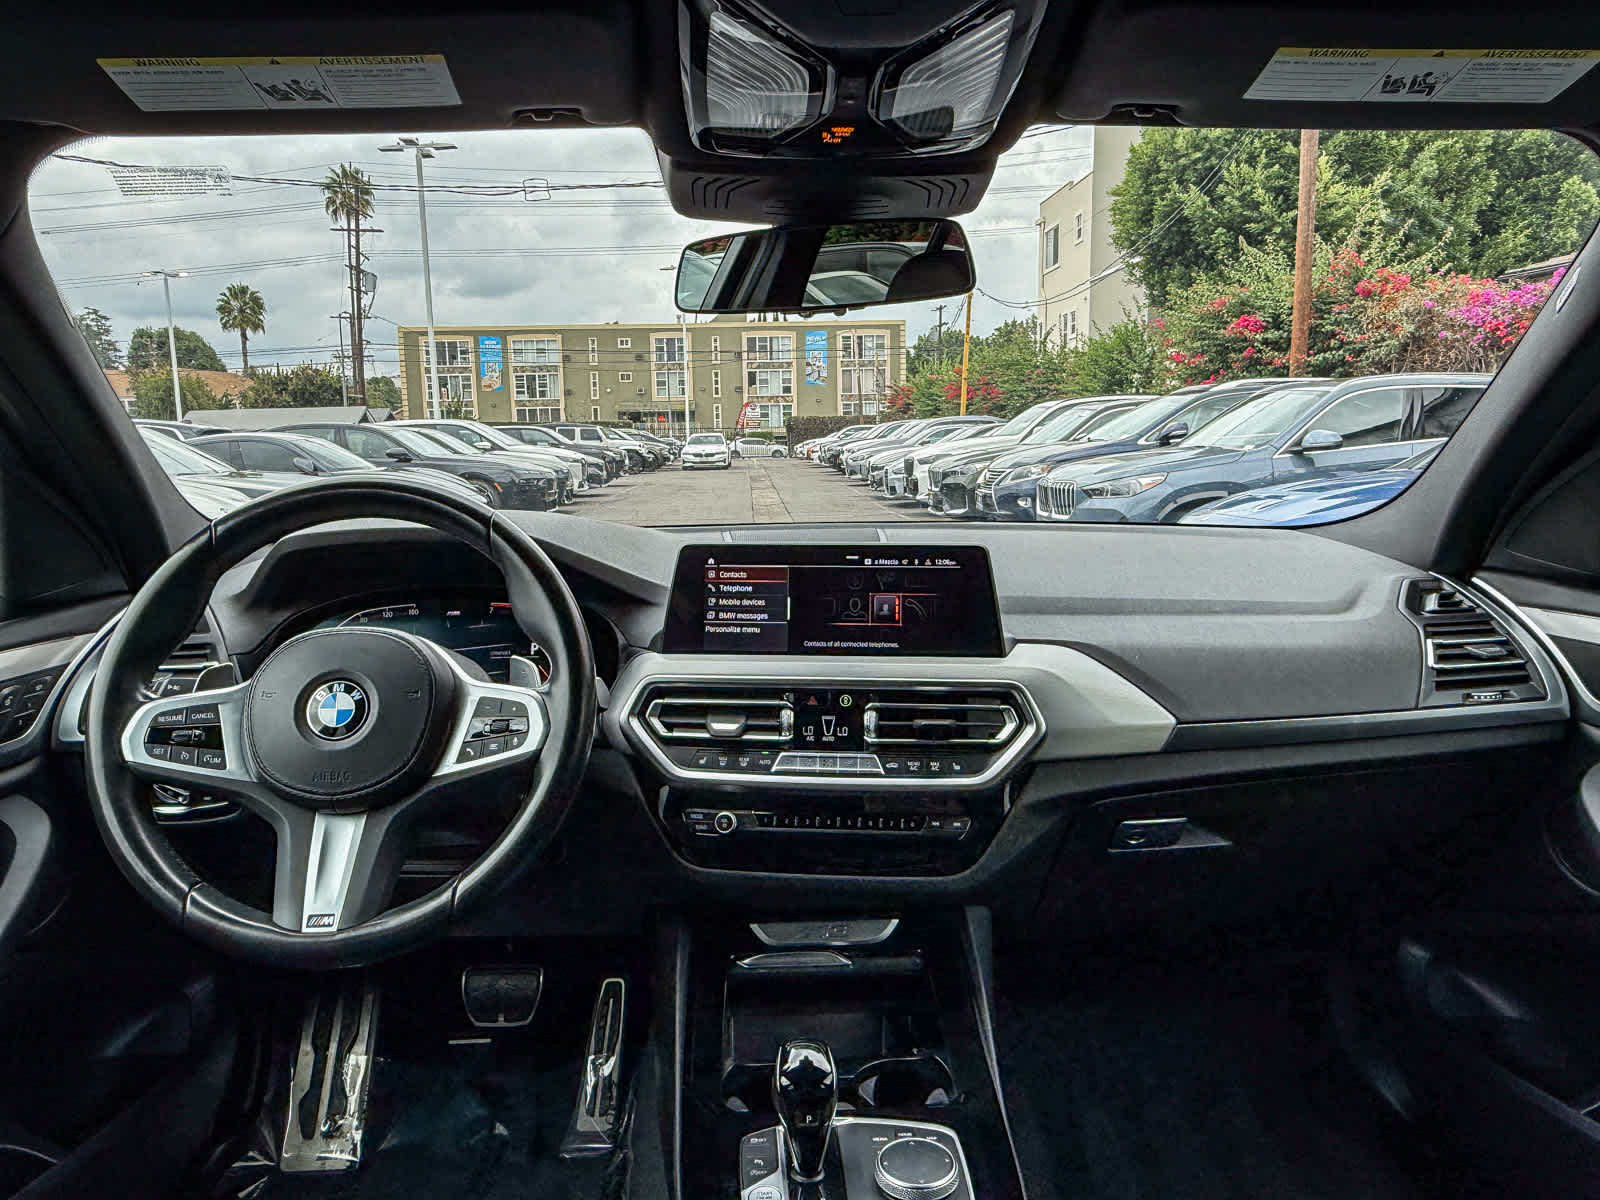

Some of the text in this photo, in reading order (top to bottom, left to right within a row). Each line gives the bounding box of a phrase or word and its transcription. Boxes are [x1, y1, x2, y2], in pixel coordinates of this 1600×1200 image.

[1308, 48, 1369, 57] WARNING
[1480, 49, 1590, 58] AVERTISSEMENT
[132, 58, 201, 67] WARNING
[319, 55, 425, 65] AVERTISSEMENT
[719, 571, 748, 579] Contacts
[719, 584, 753, 593] Telephone
[719, 598, 766, 606] Mobile devices
[736, 613, 769, 621] messages
[705, 625, 761, 634] Personalize menu
[315, 683, 363, 701] BMW
[153, 747, 164, 755] SET
